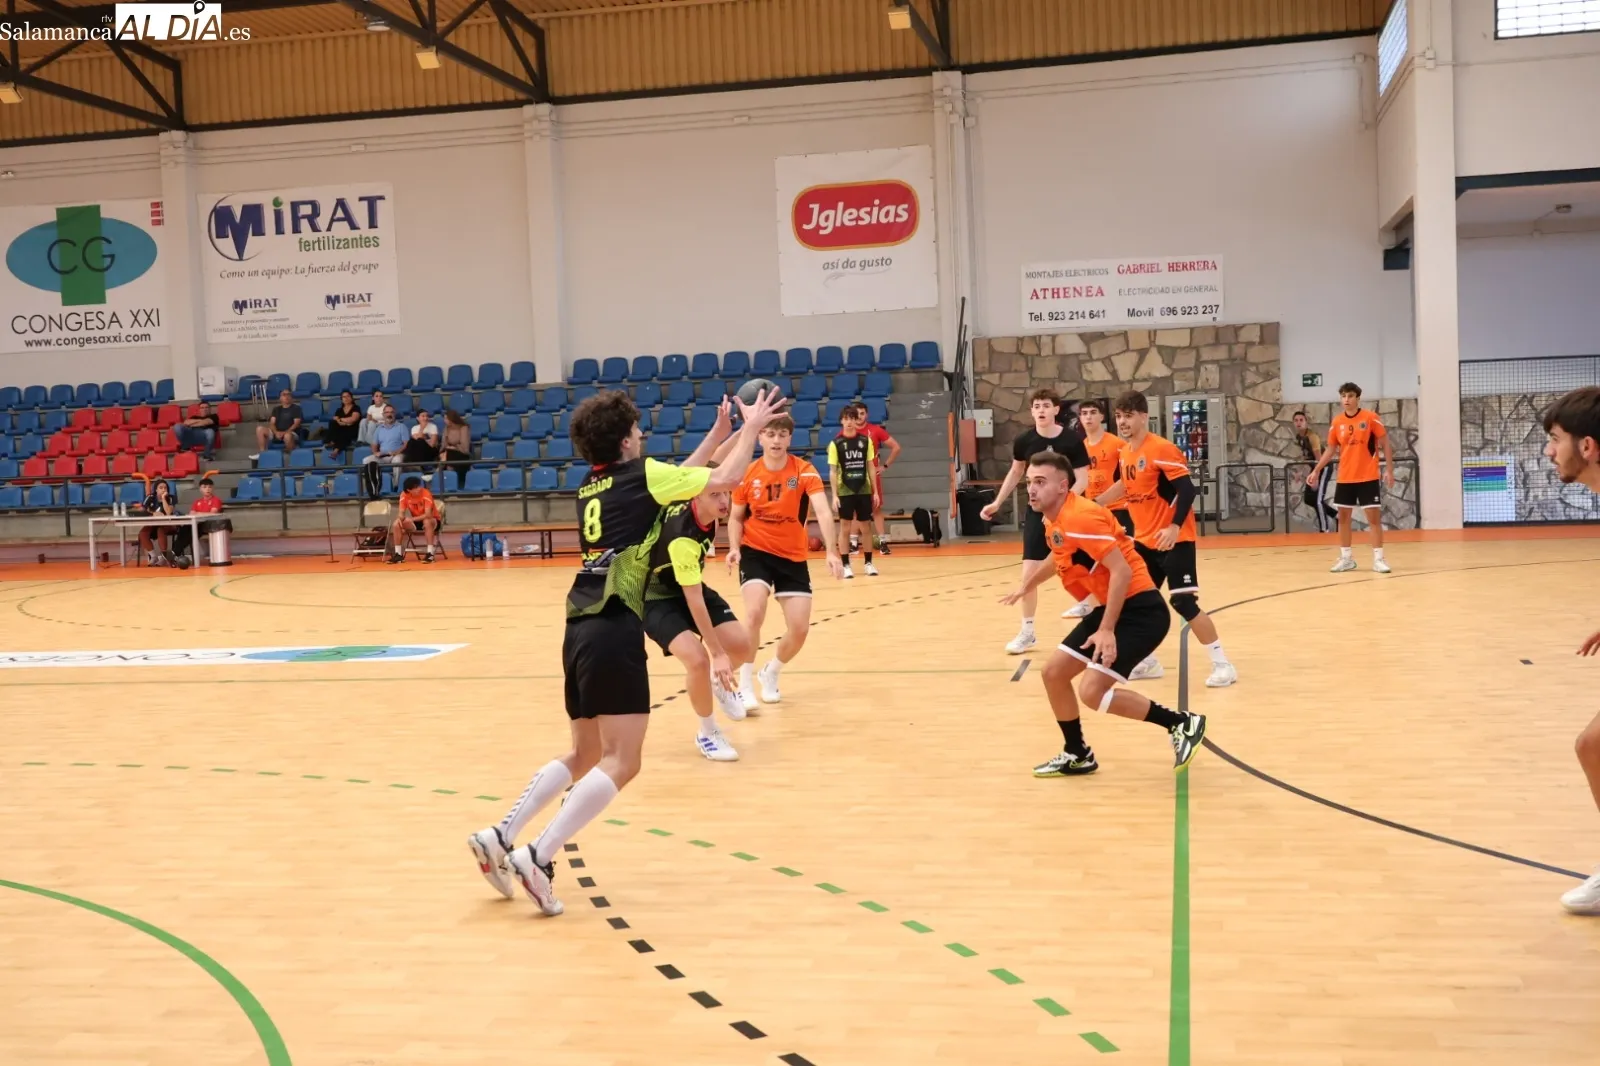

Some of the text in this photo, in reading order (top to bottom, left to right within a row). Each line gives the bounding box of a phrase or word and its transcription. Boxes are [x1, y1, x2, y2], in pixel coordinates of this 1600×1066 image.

[298, 235, 380, 252] fertilizantes
[47, 236, 116, 275] CG
[219, 261, 379, 280] Como un equipo: La fuerza del grupo
[822, 256, 892, 271] así da gusto
[1117, 260, 1218, 275] GABRIEL HERRERA
[1025, 268, 1109, 279] MONTAJES ELECTRICOS
[1030, 285, 1105, 300] ATHENEA
[1118, 284, 1218, 296] ELECTRICIDAD EN GENERAL
[1028, 309, 1106, 321] Tel. 923 214 641
[1127, 304, 1220, 317] Movil 696 923 237
[11, 308, 161, 334] CONGESA XXI
[24, 332, 152, 347] www.congesaxxi.com
[845, 449, 863, 460] UVa
[1125, 464, 1137, 480] 10
[765, 483, 783, 501] 17
[583, 498, 602, 543] 8
